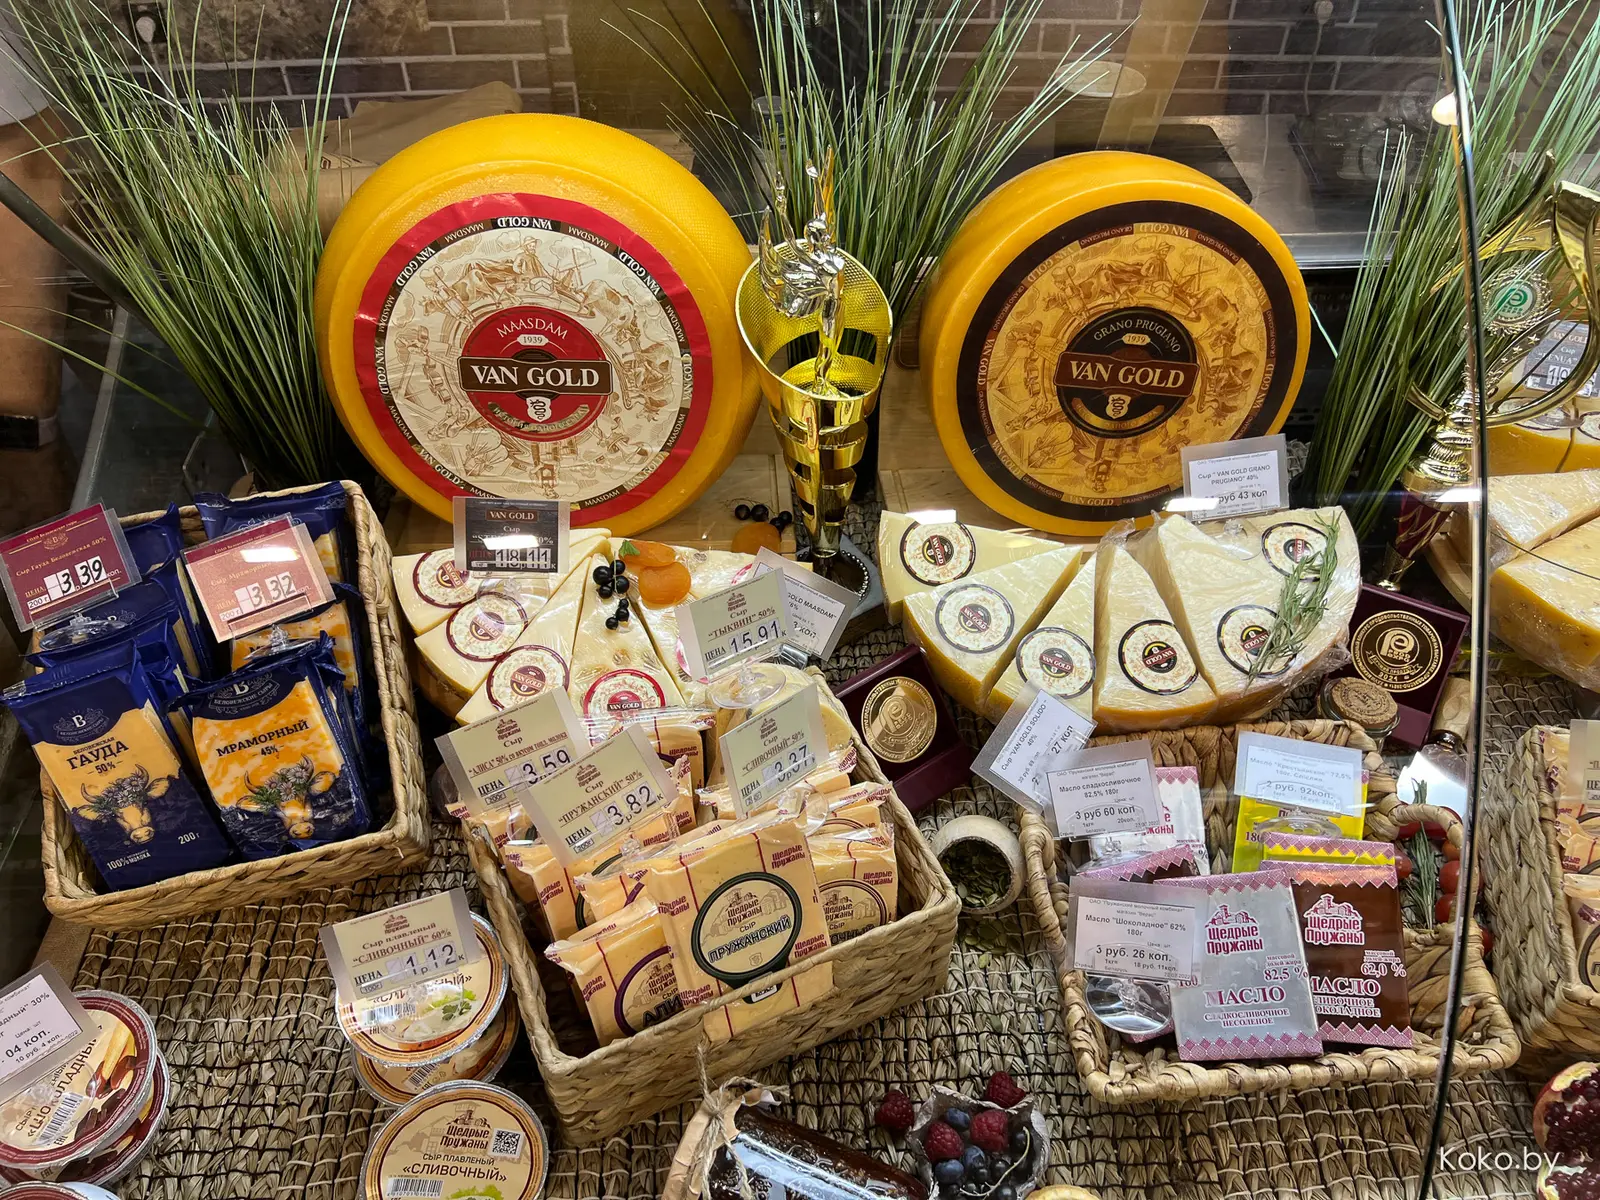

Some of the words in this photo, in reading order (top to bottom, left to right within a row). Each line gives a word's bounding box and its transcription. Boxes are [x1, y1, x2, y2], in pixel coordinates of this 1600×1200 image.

[497, 216, 530, 228] GOLD
[532, 218, 552, 230] VAN
[444, 222, 485, 243] MAASDAM
[568, 226, 609, 249] MAASDAM
[378, 295, 395, 332] MAASDAM
[496, 318, 569, 340] MAASDAM
[1094, 319, 1132, 341] GRANO
[1136, 319, 1181, 353] PRUGIANO
[523, 336, 543, 344] 1939
[1127, 335, 1145, 343] 1939
[470, 365, 519, 385] VAN
[527, 367, 600, 387] GOLD
[1070, 360, 1113, 382] VAN
[1118, 366, 1185, 388] GOLD
[1252, 392, 1265, 410] VAN
[667, 413, 686, 447] MAASDAM
[419, 449, 436, 465] VAN
[434, 463, 461, 486] GOLD
[1231, 468, 1247, 476] GOLD
[1248, 464, 1271, 473] GRANO
[584, 490, 621, 507] MAASDAM
[1218, 492, 1236, 504] руб
[1238, 491, 1249, 500] 43
[489, 511, 507, 519] VAN
[508, 511, 534, 520] GOLD
[61, 572, 72, 594] 3
[80, 559, 102, 586] 39
[251, 586, 262, 608] 3
[269, 575, 295, 600] 32
[28, 598, 43, 609] 200
[730, 608, 748, 619] Сыр
[758, 607, 776, 619] 50%
[704, 646, 726, 661] ЦЕНА
[758, 620, 780, 643] 91
[1029, 704, 1047, 727] SOLIDO
[216, 719, 310, 757] МРАМОРНЫЙ
[503, 737, 523, 748] Сыр
[763, 735, 778, 747] Сыр
[66, 741, 129, 770] ГАУДА
[260, 745, 278, 756] 45%
[1051, 741, 1063, 755] 27
[95, 762, 116, 774] 50%
[478, 779, 504, 796] ЦЕНА
[522, 763, 538, 785] 3
[543, 749, 571, 773] 59
[585, 780, 604, 794] Сыр
[741, 780, 761, 797] ЦЕНА
[1059, 783, 1081, 793] Масло
[1266, 780, 1273, 788] 2
[558, 779, 624, 823] “ПРУЖАНСКИЙ”
[625, 769, 643, 783] 50%
[565, 826, 592, 845] ЦЕНА
[607, 805, 624, 825] 3
[626, 785, 657, 815] 82
[1075, 811, 1081, 820] 3
[1083, 808, 1102, 821] руб
[1104, 807, 1115, 816] 60
[1118, 805, 1136, 815] коп
[178, 832, 196, 845] 200
[772, 844, 803, 860] Щедрые
[106, 857, 129, 871] 100%
[771, 852, 805, 869] Пружаны
[863, 870, 893, 880] Щедрые
[727, 898, 760, 917] Щедрые
[727, 905, 762, 926] Пружаны
[739, 921, 756, 933] СЫР
[1085, 914, 1111, 924] Масло
[1169, 923, 1187, 932] 62%
[1309, 916, 1360, 931] Щедрые
[362, 939, 384, 950] Сыр
[385, 922, 436, 944] плавленый
[708, 914, 792, 963] ПРУЖАНСКИЙ
[1127, 929, 1143, 937] 180г
[1208, 925, 1259, 941] Щедрые
[1306, 929, 1365, 944] Пружаны
[352, 935, 429, 965] “СЛИВОЧНЫЙ”
[431, 929, 451, 941] 60%
[794, 933, 825, 950] Щедрые
[1206, 938, 1263, 956] Пружаны
[1096, 945, 1102, 954] 3
[1105, 947, 1129, 960] руб.
[1132, 949, 1146, 959] 26
[1148, 952, 1172, 963] коп.
[1264, 967, 1290, 982] 82,5
[1361, 962, 1388, 976] 62,0
[1391, 963, 1407, 977] %
[354, 971, 383, 985] ЦЕНА
[32, 993, 50, 1007] 30%
[1205, 986, 1286, 1007] МАСЛО
[1222, 1017, 1274, 1027] НЕСОЛЕНОЕ
[5, 1043, 22, 1059] 04
[24, 1030, 51, 1048] коп.
[446, 1125, 490, 1139] Щедрые
[440, 1136, 488, 1149] Пружаны
[423, 1153, 441, 1161] СЫР
[443, 1154, 495, 1166] ПЛАВЛЕНЫЙ
[402, 1163, 507, 1182] «СЛИВОЧНЫЙ»
